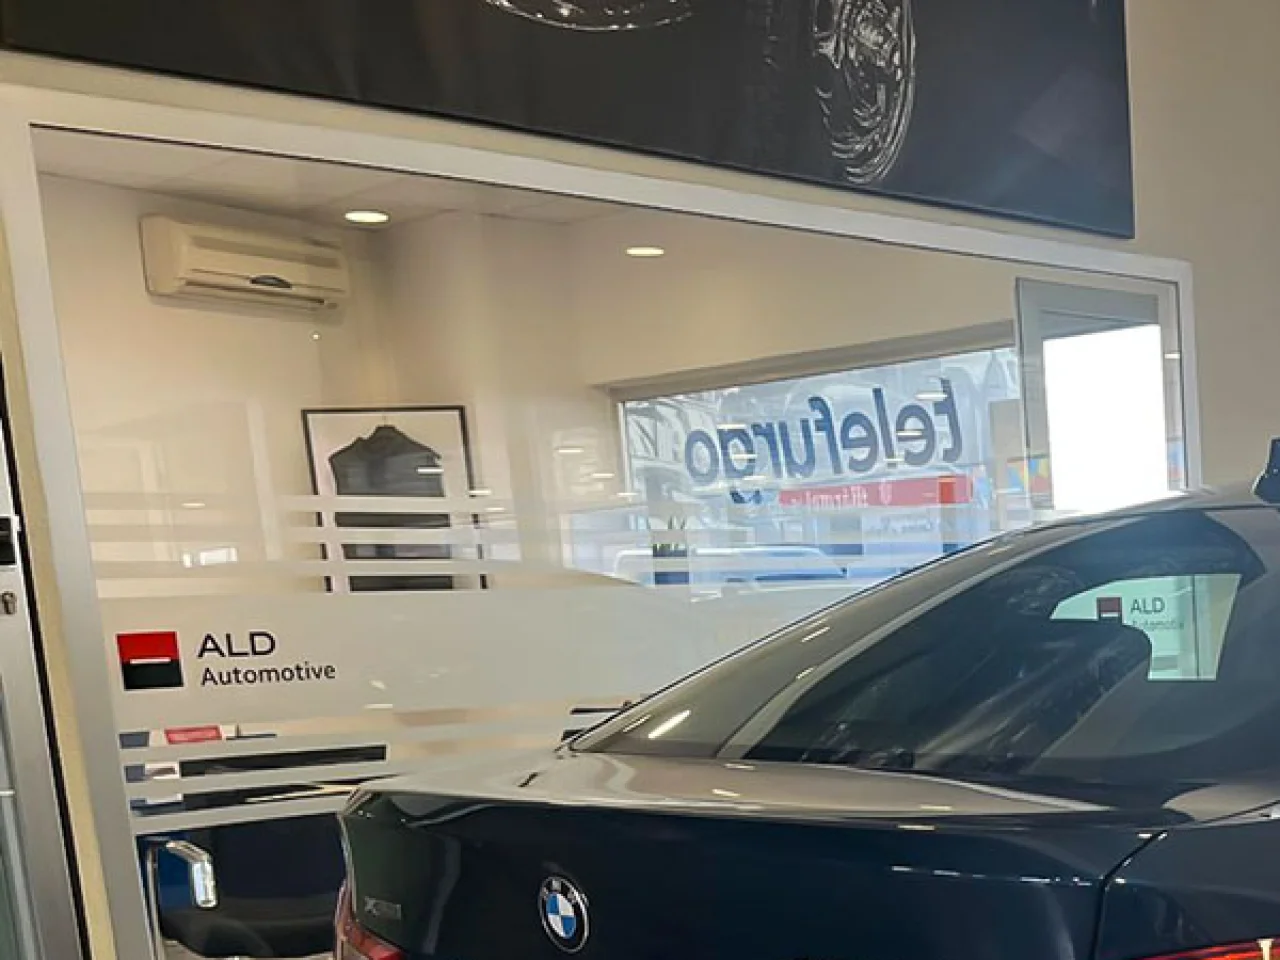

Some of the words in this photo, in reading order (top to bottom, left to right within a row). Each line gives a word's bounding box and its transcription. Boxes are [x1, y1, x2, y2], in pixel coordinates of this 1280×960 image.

[1130, 596, 1166, 615] ALD
[197, 631, 276, 659] ALD
[200, 660, 337, 687] Automotive
